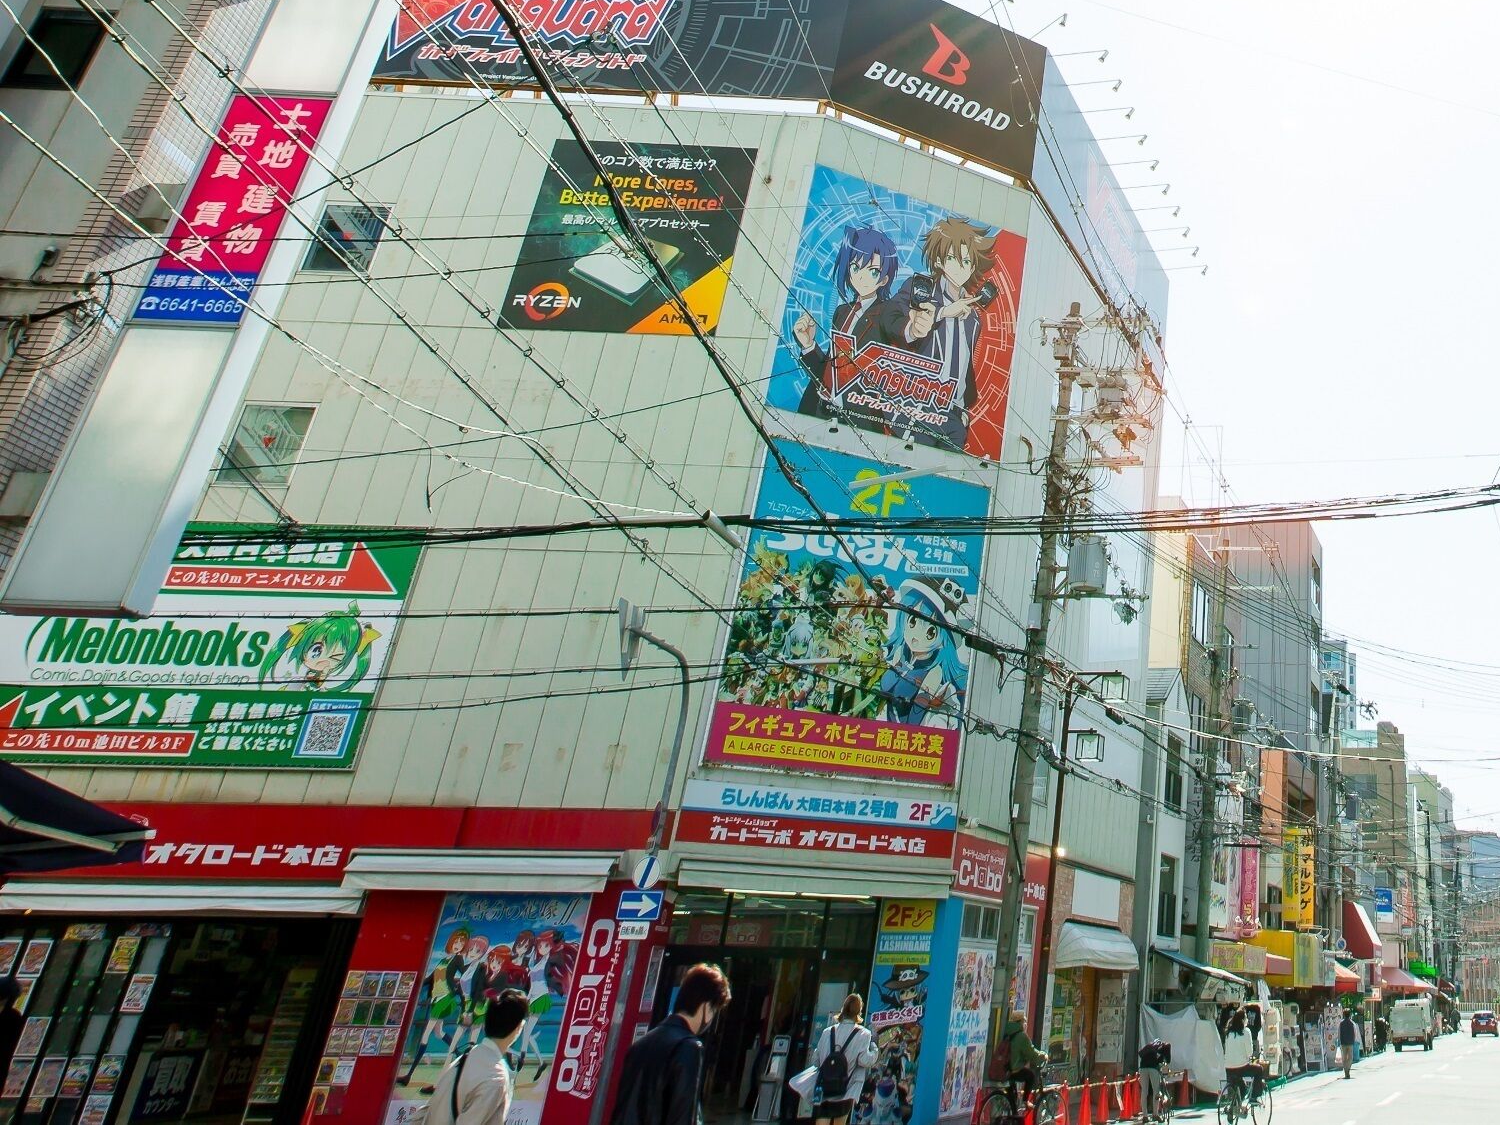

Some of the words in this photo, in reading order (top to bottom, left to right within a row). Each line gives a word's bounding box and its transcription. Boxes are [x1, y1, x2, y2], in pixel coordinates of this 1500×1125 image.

[862, 60, 1012, 133] BUSHIROAD
[257, 102, 312, 169] 土地
[210, 122, 262, 181] 売買
[645, 174, 699, 193] Cores,
[621, 191, 725, 213] Experience!
[221, 183, 277, 255] 建物
[159, 297, 243, 314] 6641-6665
[512, 293, 583, 309] RYZEN
[850, 468, 911, 518] 2F
[909, 565, 968, 575] LASHINBANG
[924, 546, 954, 563] 2号館
[36, 617, 271, 669] Melonbooks
[22, 690, 201, 729] イベント館
[728, 711, 945, 757] フィギュア・ホビー商品充実
[727, 740, 736, 750] A
[740, 740, 777, 755] LARGE
[780, 744, 836, 761] SELECTION
[839, 751, 853, 762] OF
[721, 787, 794, 811] らしんばん
[796, 796, 857, 815] 大阪日本橋
[858, 799, 900, 820] 2号館
[907, 803, 933, 822] 2F
[712, 815, 779, 827] カードゲームショップ
[145, 842, 344, 866] オタロード本店
[709, 825, 794, 846] カードラボ
[797, 829, 927, 854] オタロード本店
[959, 859, 1003, 893] C-labo
[884, 903, 915, 927] 2F
[555, 917, 616, 1093] C-labo
